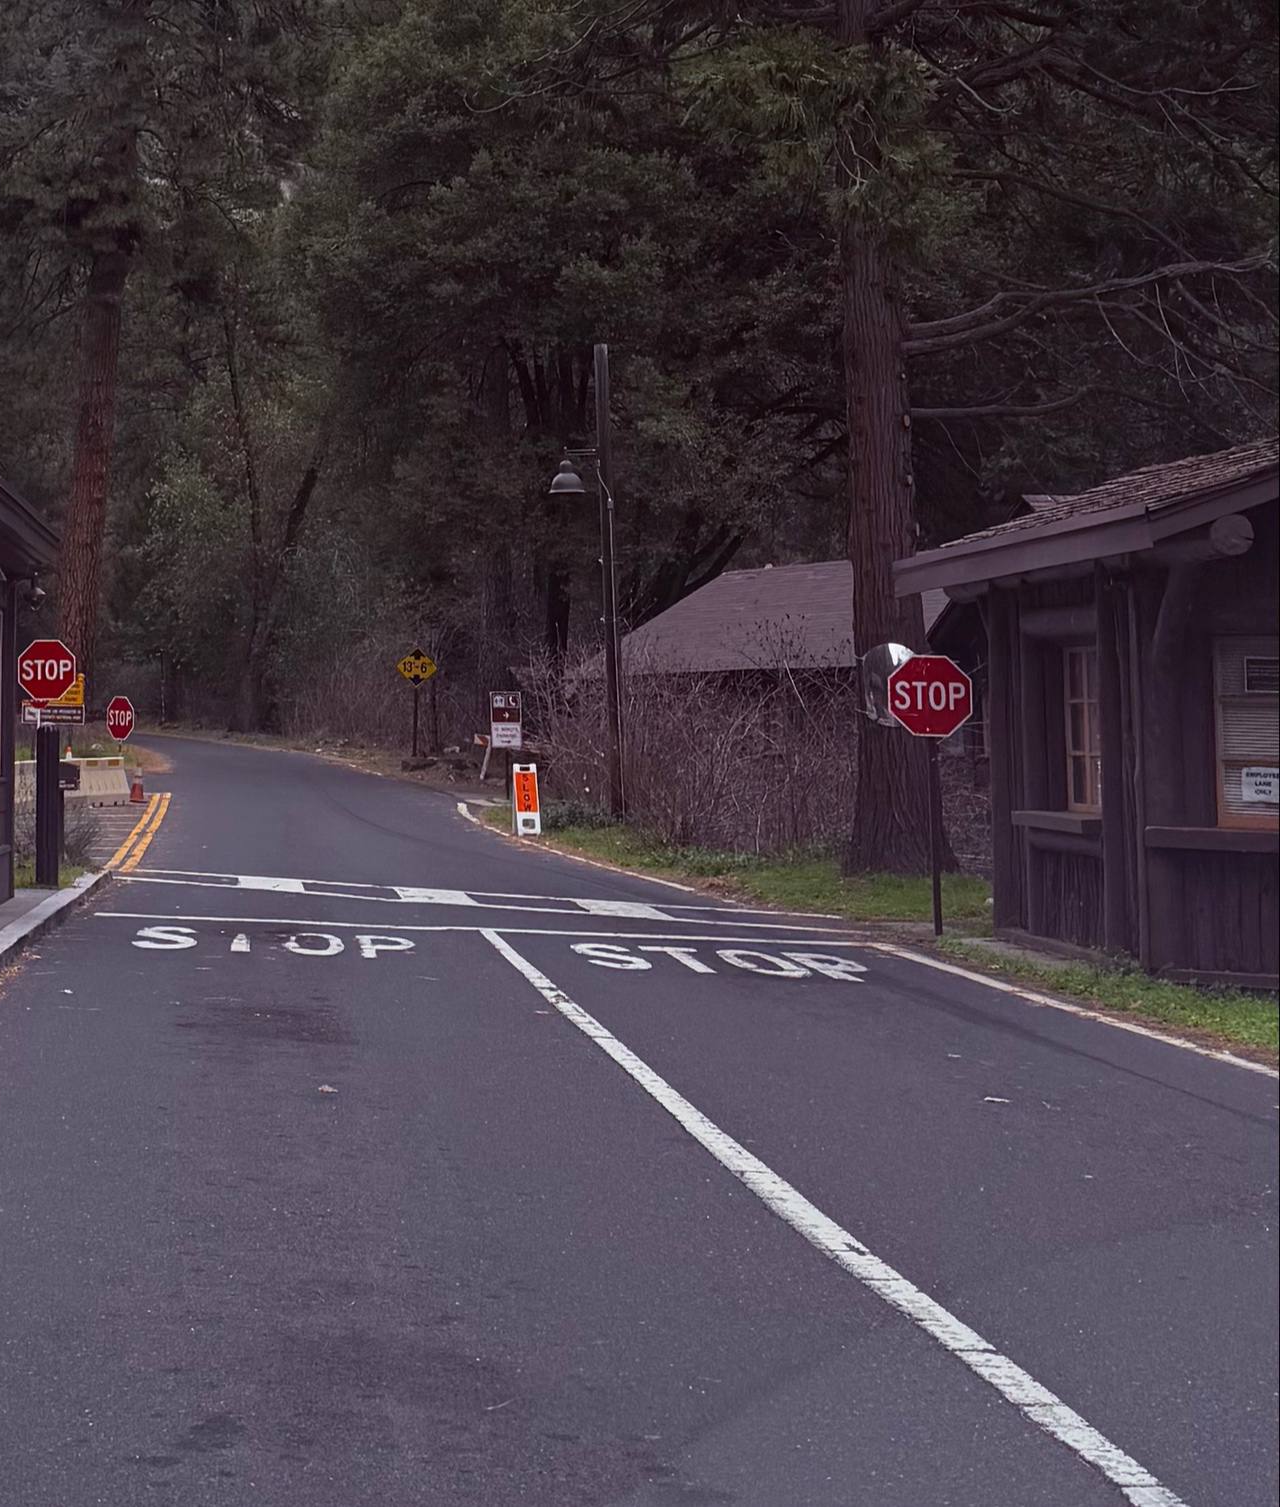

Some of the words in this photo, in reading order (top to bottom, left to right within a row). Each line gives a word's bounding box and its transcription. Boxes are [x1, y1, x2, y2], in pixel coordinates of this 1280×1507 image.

[22, 660, 72, 681] STOP
[894, 681, 966, 711] STOP
[109, 710, 132, 726] STOP
[522, 773, 532, 812] SLOW
[570, 943, 868, 983] STOP
